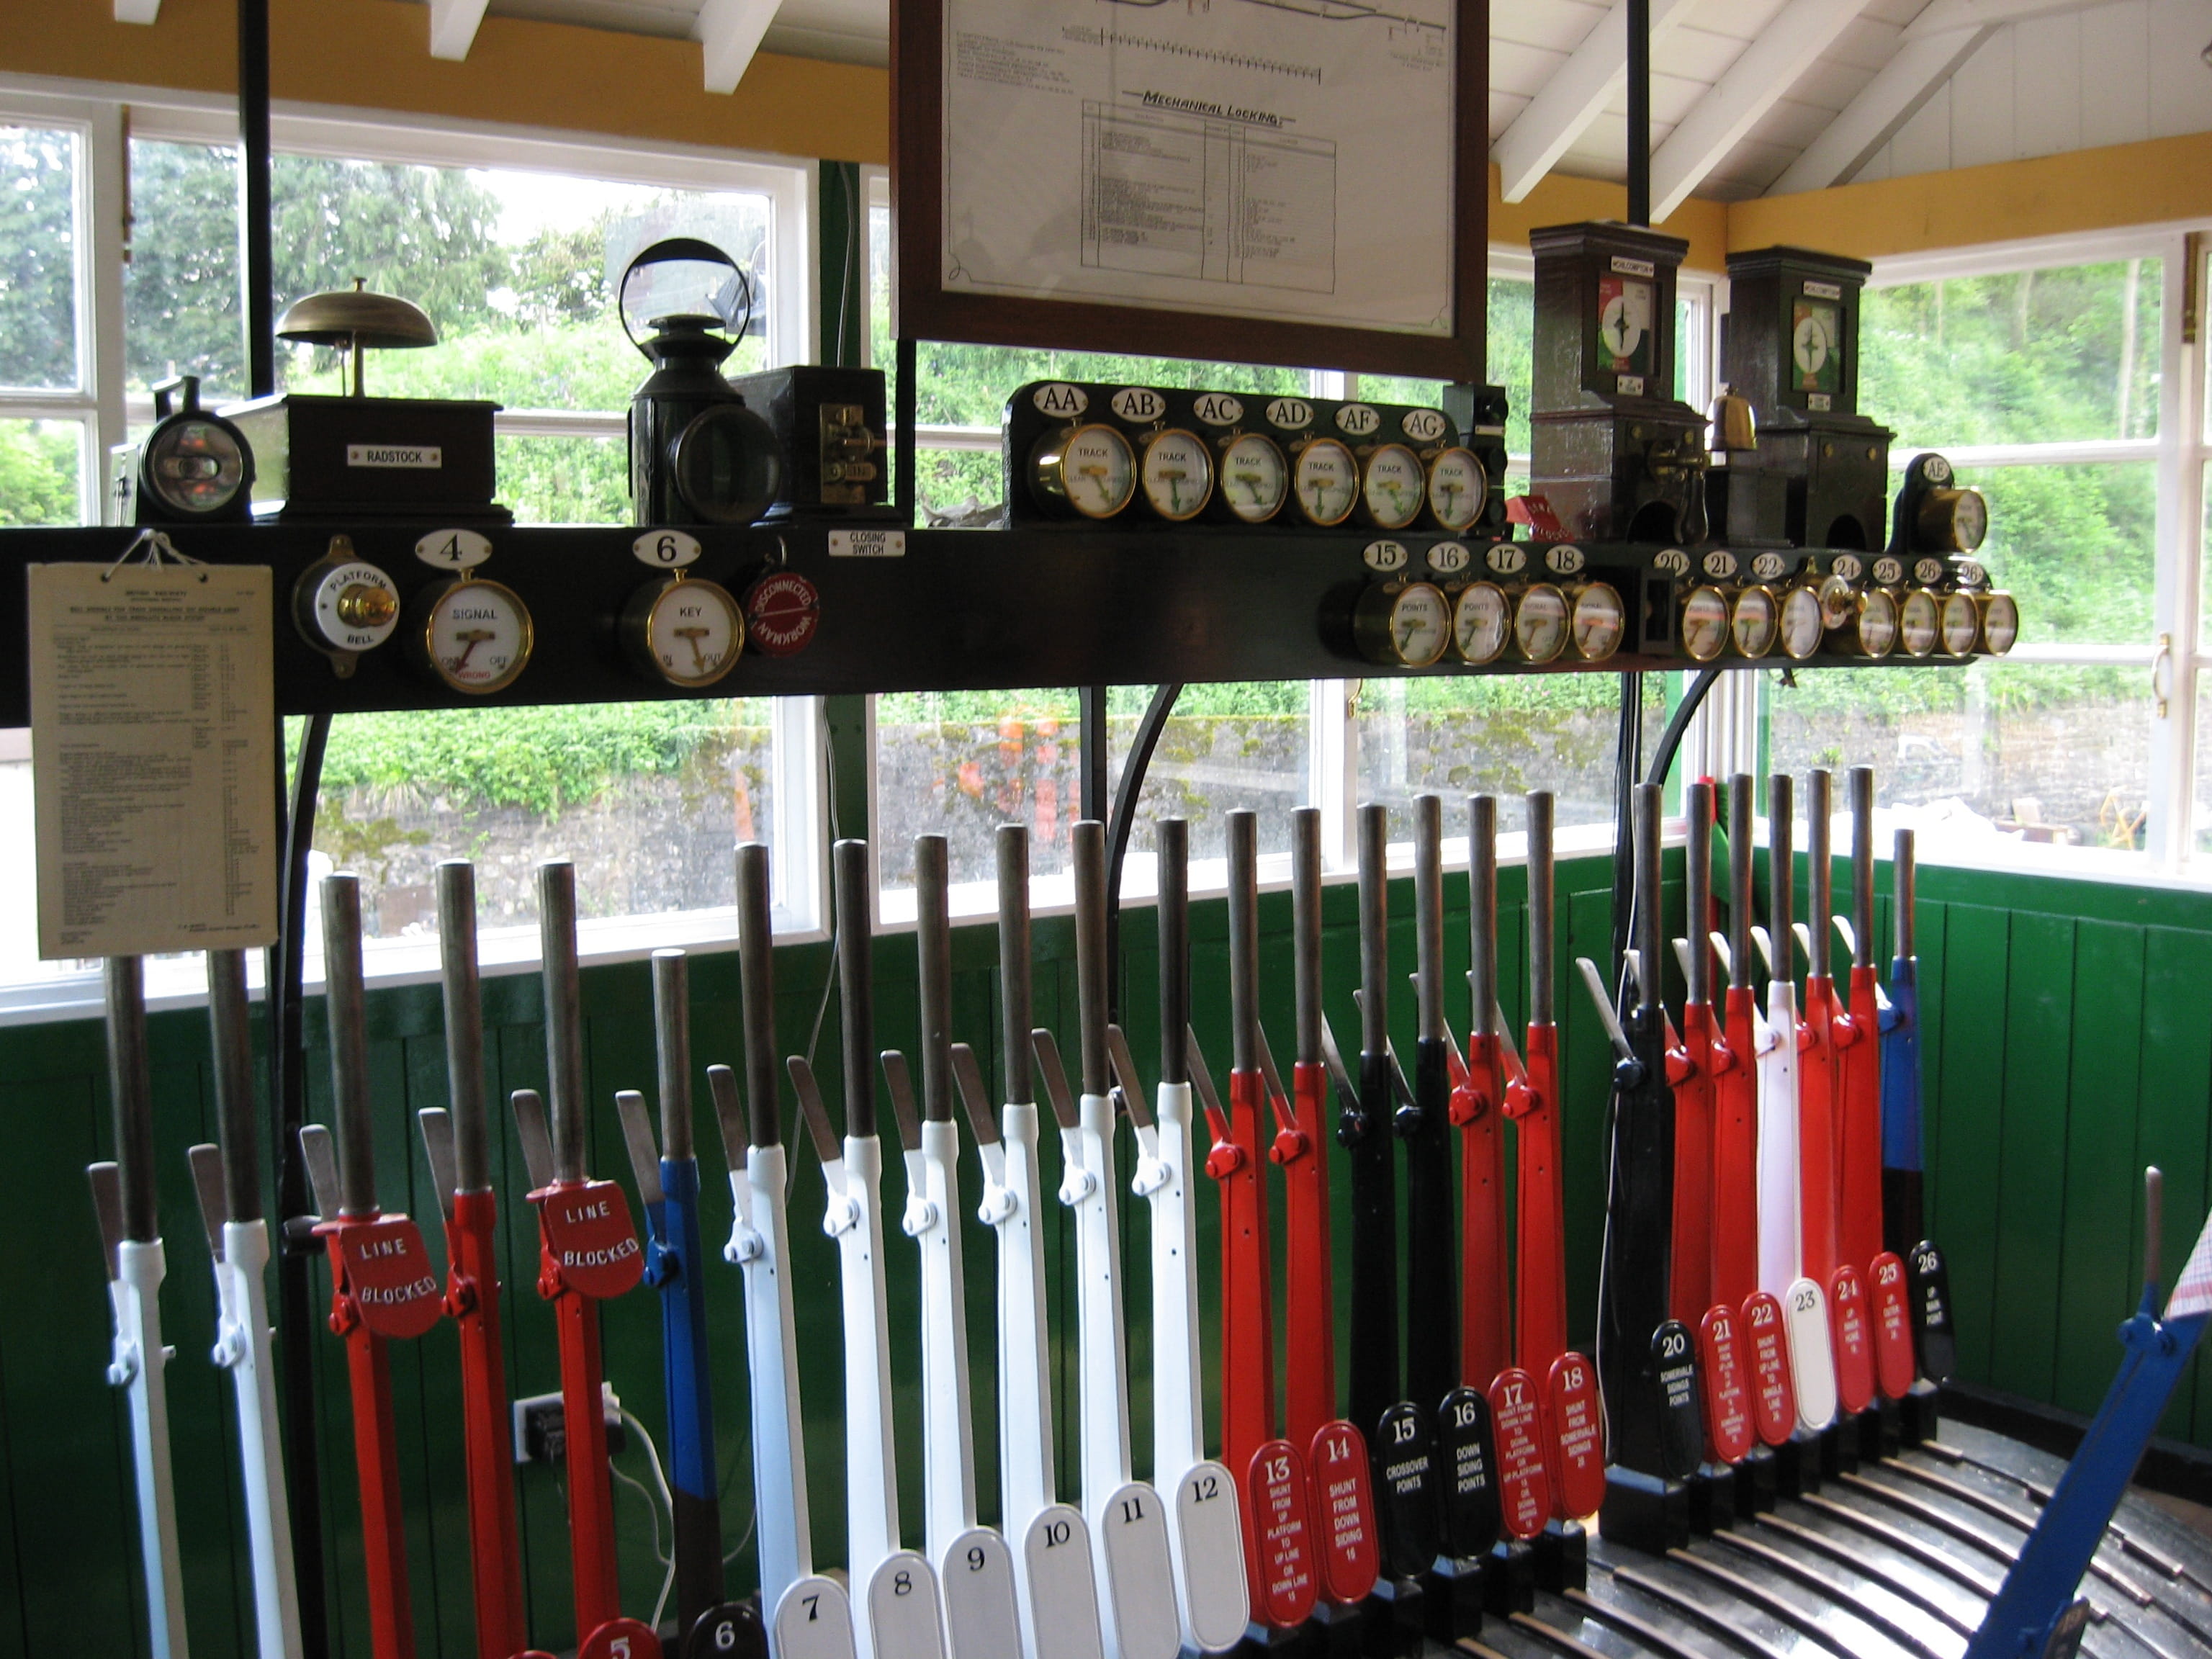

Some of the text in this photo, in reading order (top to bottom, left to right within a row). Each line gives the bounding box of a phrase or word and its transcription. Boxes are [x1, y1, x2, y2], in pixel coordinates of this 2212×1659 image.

[1043, 386, 1079, 411] AA
[1122, 392, 1156, 416] AB
[1202, 395, 1234, 421] AC
[1274, 401, 1307, 425] AD
[1343, 409, 1372, 431] AF
[1408, 414, 1439, 437] AG
[367, 450, 423, 463] RADSTOCK
[1079, 447, 1109, 458] TRACK
[1158, 451, 1187, 462] TRACK
[1235, 457, 1262, 467] TRACK
[1308, 461, 1335, 472] TRACK
[1377, 464, 1403, 475] TRACK
[1440, 467, 1465, 477] TRACK
[439, 533, 462, 561] 4
[850, 531, 886, 543] CLOSING
[657, 536, 677, 562] 6
[853, 544, 884, 555] SWITCH
[1375, 544, 1397, 565] 15
[1439, 544, 1460, 567] 16
[1496, 547, 1514, 569] 17
[1555, 549, 1575, 571] 18
[1710, 552, 1727, 574] 21
[1758, 554, 1778, 575] 22
[1838, 559, 1855, 576] 24
[1878, 563, 1895, 579] 25
[1920, 562, 1936, 578] 26
[330, 570, 387, 591] PLATFORM
[754, 579, 811, 612] DISCONNECTED
[452, 608, 498, 621] SIGNAL
[679, 606, 702, 617] KEY
[1401, 603, 1428, 612] POINTS
[1464, 603, 1490, 611] POINTS
[346, 634, 374, 644] BELL
[757, 616, 812, 645] WORKMAN
[458, 670, 491, 679] WRONG
[565, 1200, 611, 1223] LINE
[361, 1238, 407, 1260] LINE
[564, 1237, 639, 1267] BLOCKED
[1879, 1262, 1898, 1285] 25
[1917, 1251, 1938, 1274] 26
[361, 1277, 436, 1305] BLOCKED
[1838, 1277, 1858, 1301] 24
[1795, 1290, 1816, 1312] 23
[1751, 1303, 1773, 1328] 22
[1712, 1318, 1731, 1341] 21
[1662, 1333, 1686, 1358] 20
[1562, 1367, 1583, 1392] 18
[1503, 1382, 1523, 1408] 17
[1452, 1401, 1475, 1428] 16
[1393, 1416, 1416, 1444] 15
[1326, 1436, 1350, 1463] 14
[1456, 1442, 1481, 1461] DOWN
[1264, 1455, 1291, 1485] 13
[1386, 1455, 1429, 1480] CROSSOVER
[1457, 1457, 1483, 1478] SIDING
[1192, 1476, 1218, 1503] 12
[1269, 1482, 1292, 1500] SHUNT
[1328, 1477, 1357, 1498] SHUNT
[1395, 1474, 1422, 1495] POINTS
[1457, 1473, 1485, 1493] POINTS
[1120, 1496, 1145, 1524] 11
[1272, 1496, 1292, 1512] FROM
[1333, 1495, 1357, 1514] FROM
[1277, 1510, 1288, 1524] UP
[1334, 1511, 1360, 1531] DOWN
[1044, 1521, 1071, 1549] 10
[1267, 1519, 1303, 1540] PLATFORM
[1334, 1527, 1363, 1548] SIDING
[967, 1546, 985, 1571] 9
[1274, 1547, 1300, 1565] UP LINE
[894, 1570, 912, 1596] 8
[801, 1593, 820, 1622] 7
[715, 1621, 736, 1650] 6
[610, 1637, 631, 1659] 5
